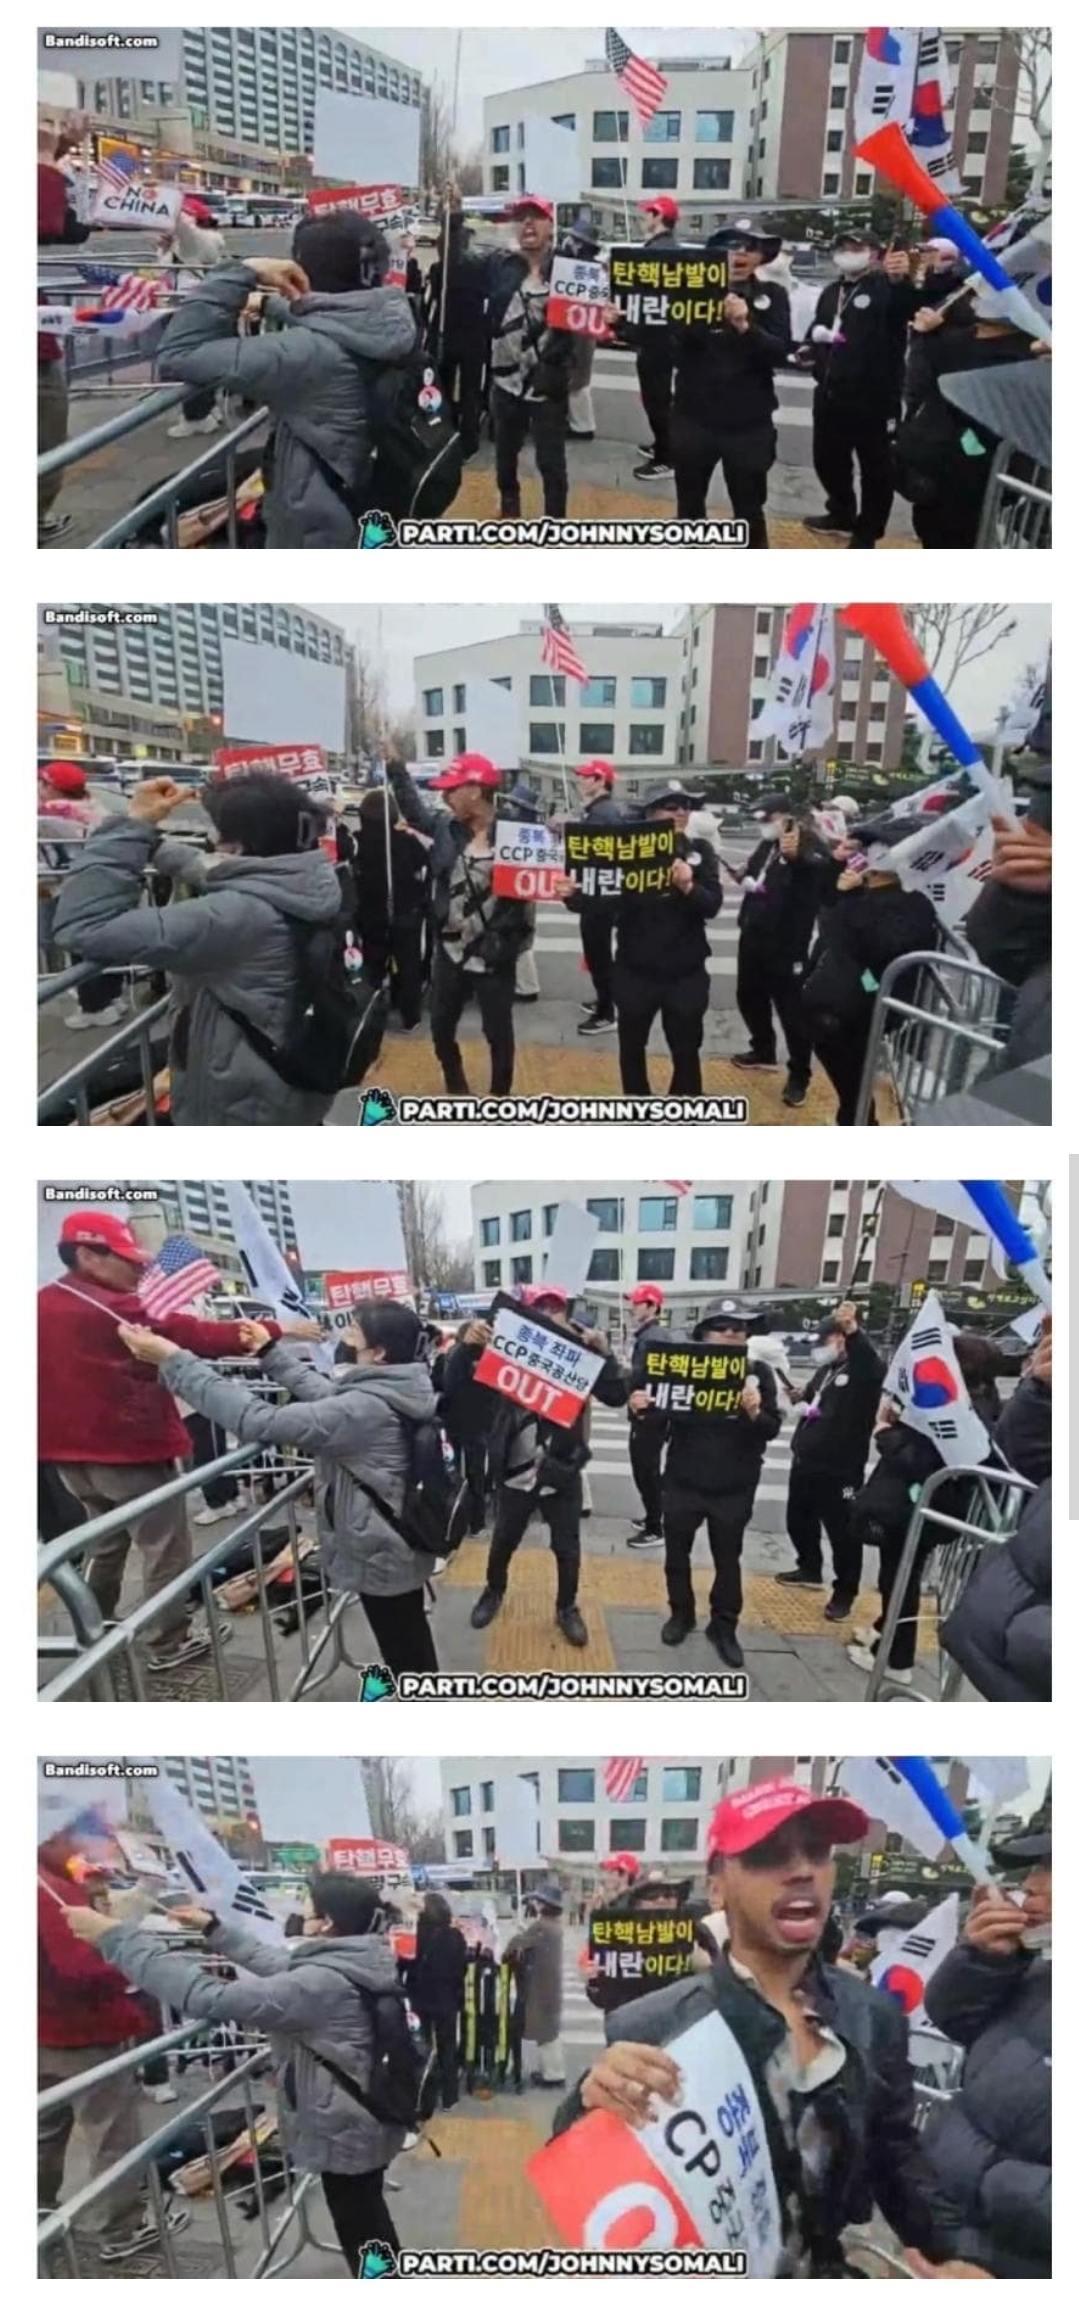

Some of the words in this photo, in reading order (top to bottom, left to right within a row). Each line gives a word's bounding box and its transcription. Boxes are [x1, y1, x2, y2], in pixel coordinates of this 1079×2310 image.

[104, 196, 169, 217] CHINA
[613, 261, 726, 289] 탄핵남발이
[614, 294, 723, 325] 내란이다!
[568, 831, 673, 861] 탄핵남발이
[569, 867, 671, 896] 내란이다!
[517, 1324, 549, 1351] 종북
[550, 1342, 582, 1368] 좌파
[647, 1353, 746, 1380] 탄핵남발이
[497, 1365, 562, 1412] OUT
[645, 1383, 743, 1411] 내란이다!
[593, 1919, 693, 1945] 탄핵남발이
[593, 1951, 692, 1978] 내란이다!
